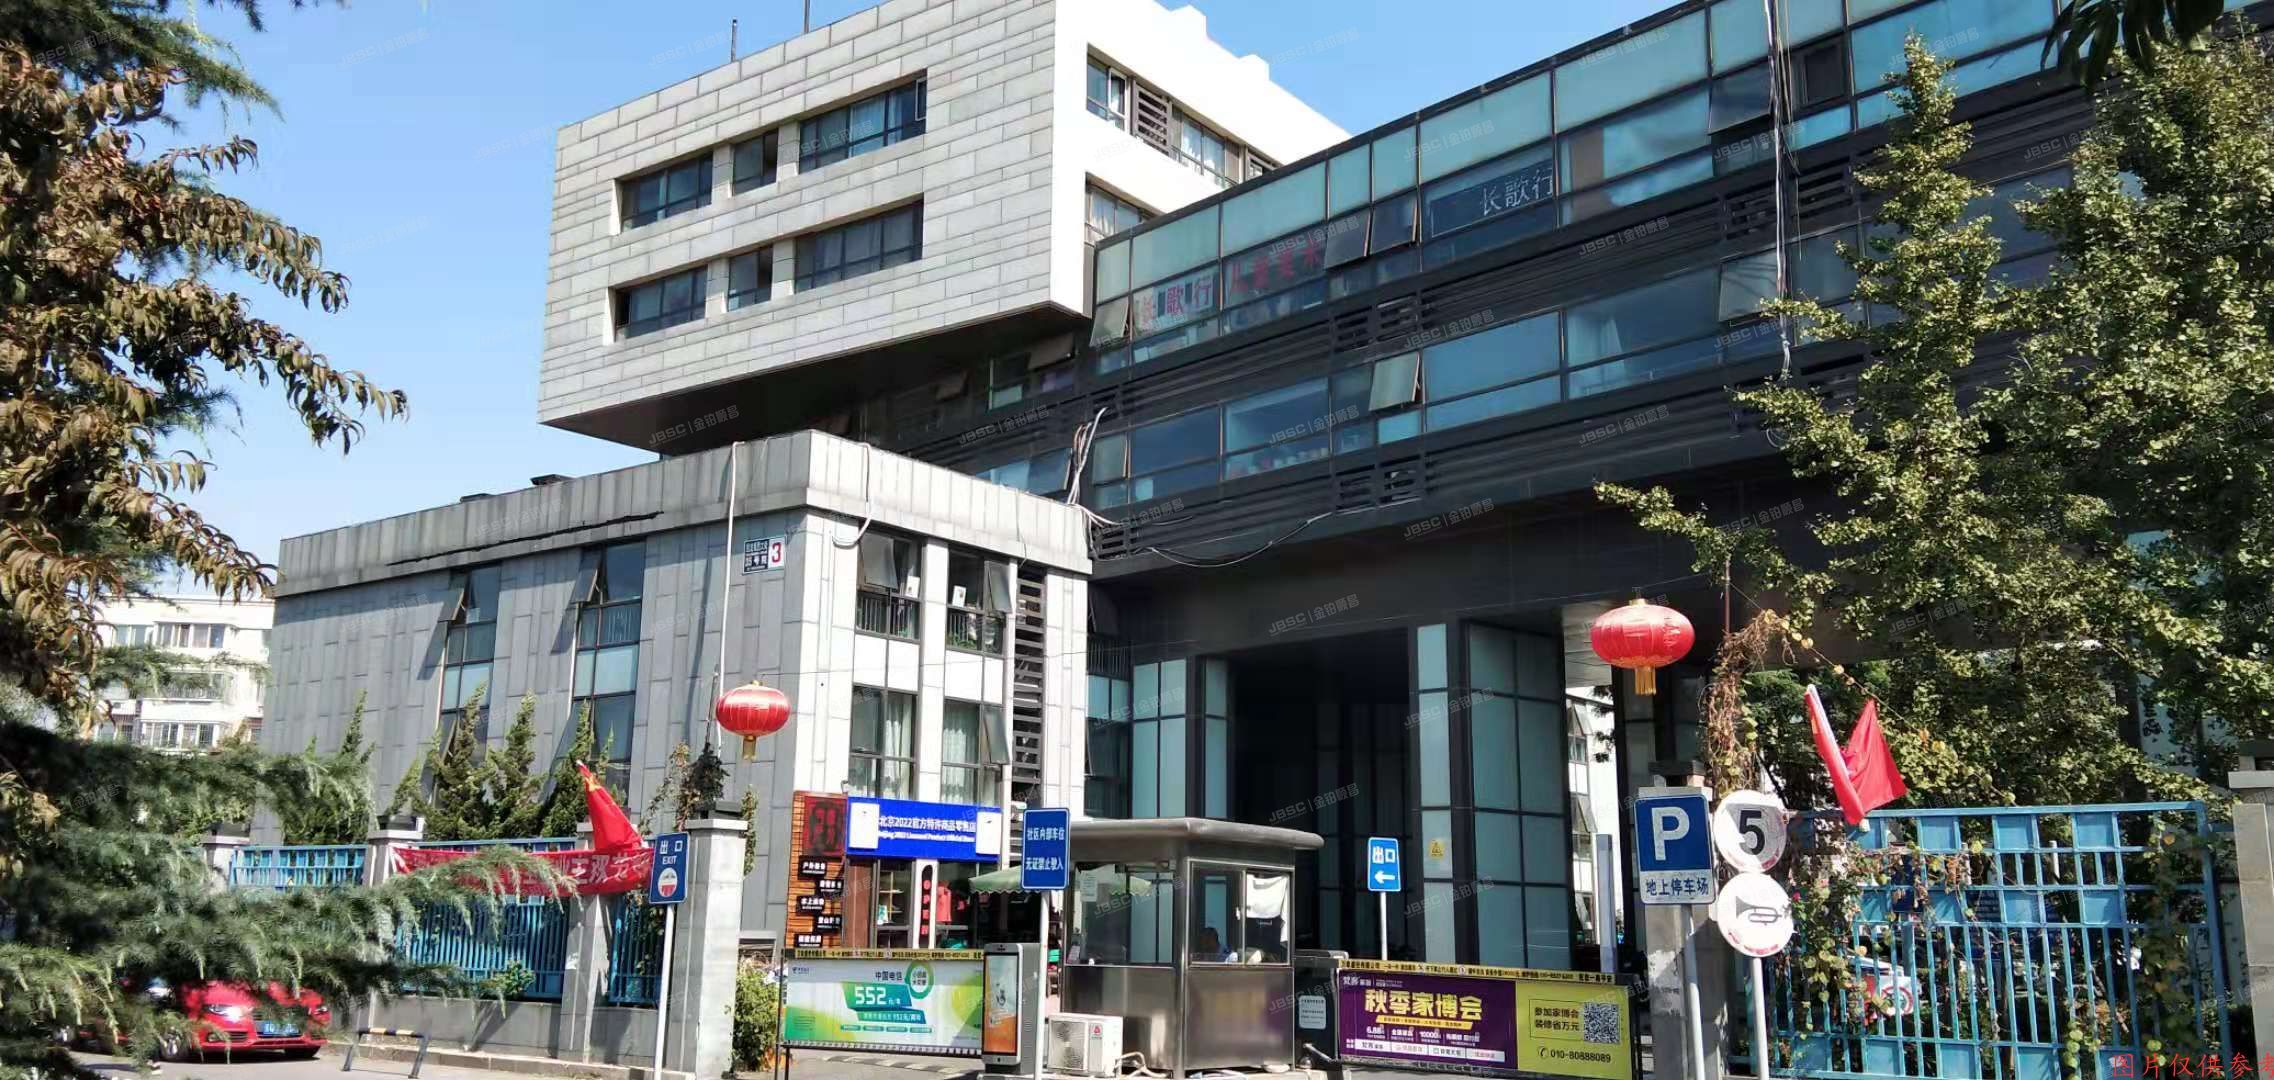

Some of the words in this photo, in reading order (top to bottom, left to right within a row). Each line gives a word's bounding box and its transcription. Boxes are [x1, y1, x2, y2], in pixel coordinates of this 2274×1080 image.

[1480, 167, 1553, 215] 长歌行
[772, 542, 782, 564] 3
[1651, 806, 1690, 861] P
[1739, 809, 1765, 856] 5
[660, 840, 683, 854] 出口
[1372, 845, 1396, 864] 出口
[662, 855, 677, 865] EXIT
[1025, 856, 1064, 871] 无证禁止驶入
[1645, 877, 1710, 896] 地上停车场
[874, 971, 903, 982] 中国电信
[855, 985, 887, 1004] 552
[1364, 988, 1483, 1021] 秋季家博会
[1535, 1007, 1579, 1019] 参加家博会
[1535, 1019, 1580, 1031] 装修省万元
